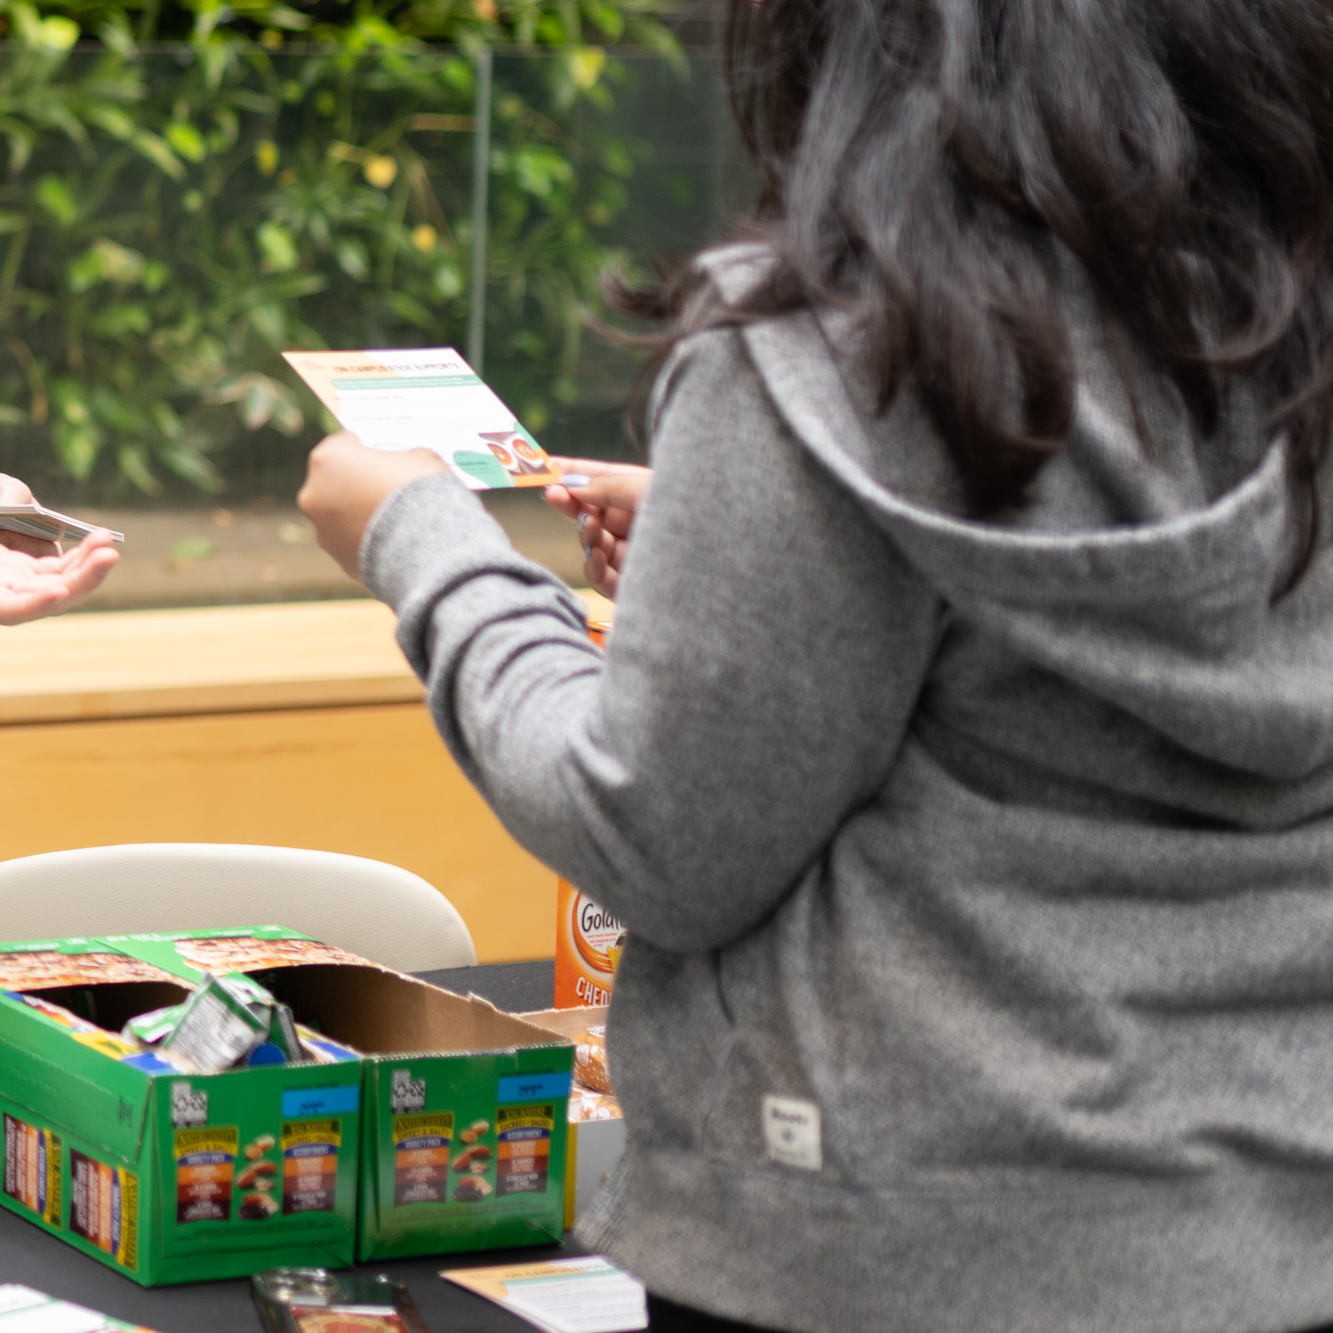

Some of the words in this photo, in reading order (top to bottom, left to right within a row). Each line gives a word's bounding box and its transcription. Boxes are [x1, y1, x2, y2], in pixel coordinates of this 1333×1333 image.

[581, 902, 628, 932] Gold
[576, 976, 612, 1006] CHED
[405, 1139, 427, 1148] VARIETY
[428, 1138, 441, 1147] PACK
